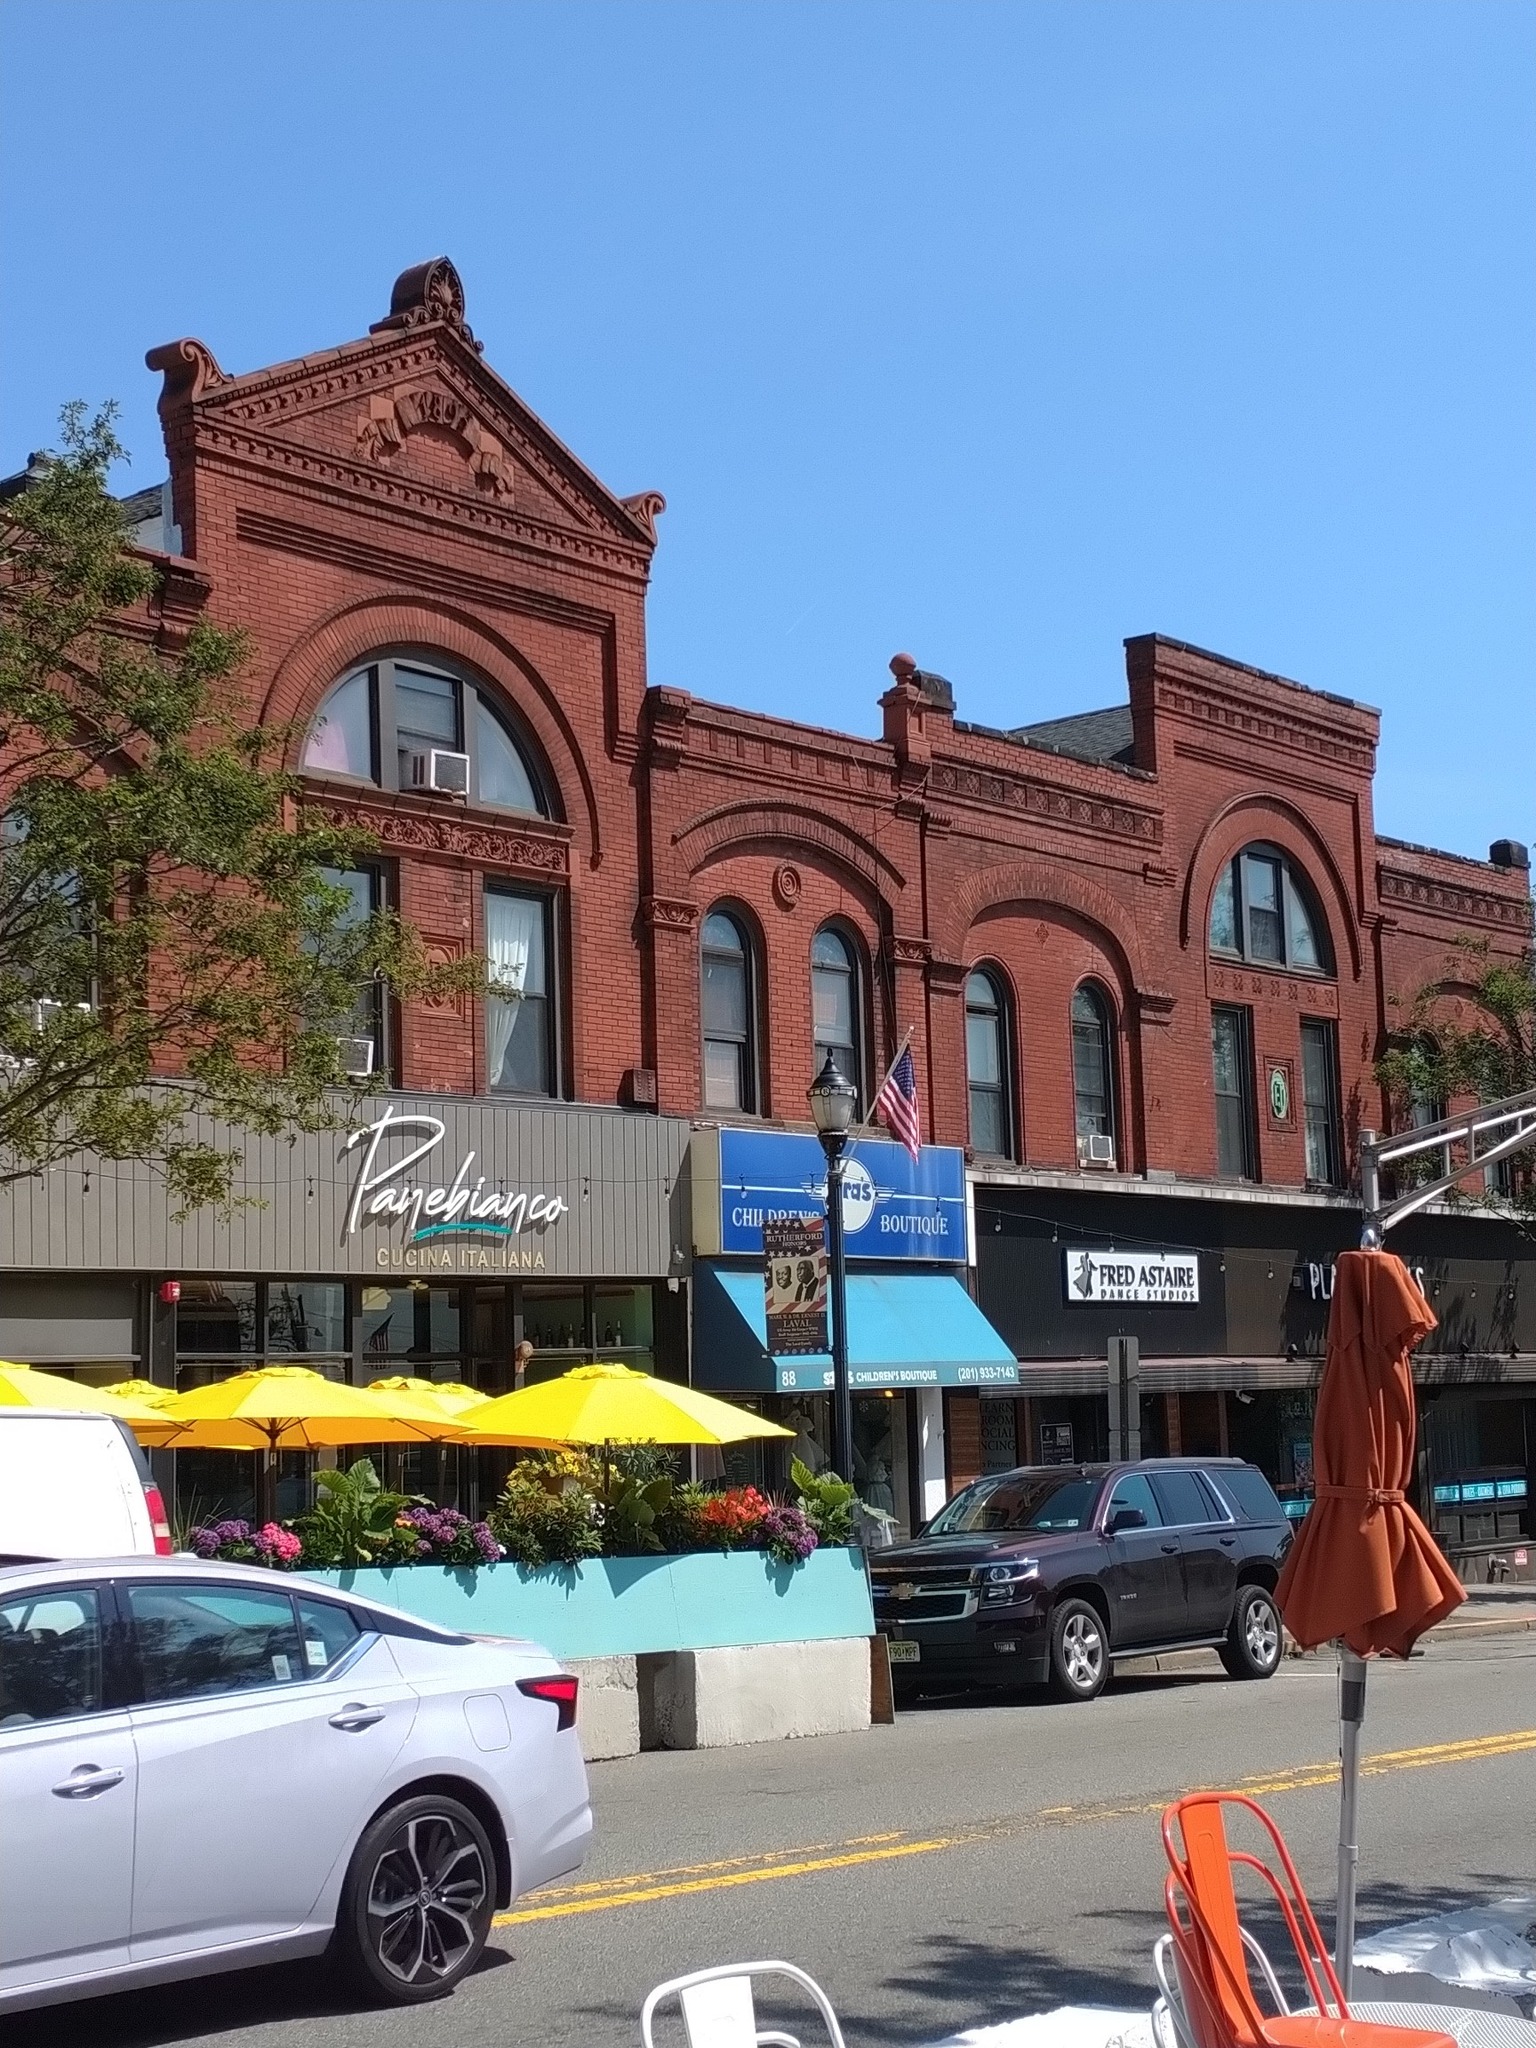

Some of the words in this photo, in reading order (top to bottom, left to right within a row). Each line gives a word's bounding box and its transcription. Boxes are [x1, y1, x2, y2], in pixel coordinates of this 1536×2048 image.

[347, 1105, 569, 1233] Panebianco
[881, 1214, 949, 1237] BOUTIQUE
[766, 1232, 823, 1243] RUTHERFORD
[376, 1248, 452, 1267] CUCINA
[461, 1250, 545, 1269] ITALIANA
[1099, 1264, 1135, 1287] FRED
[1138, 1265, 1195, 1288] ASTAIRE
[1101, 1289, 1139, 1300] DANCE
[1146, 1289, 1195, 1300] STUDIOS
[783, 1319, 811, 1328] LAVAL
[782, 1370, 797, 1386] 88
[856, 1370, 899, 1382] CHILDREN'S
[900, 1369, 937, 1381] BOUTIQUE
[958, 1367, 978, 1382] (201)
[979, 1365, 1015, 1379] 933-7143
[982, 1402, 1014, 1413] EARN
[981, 1427, 1015, 1438] OCIAL
